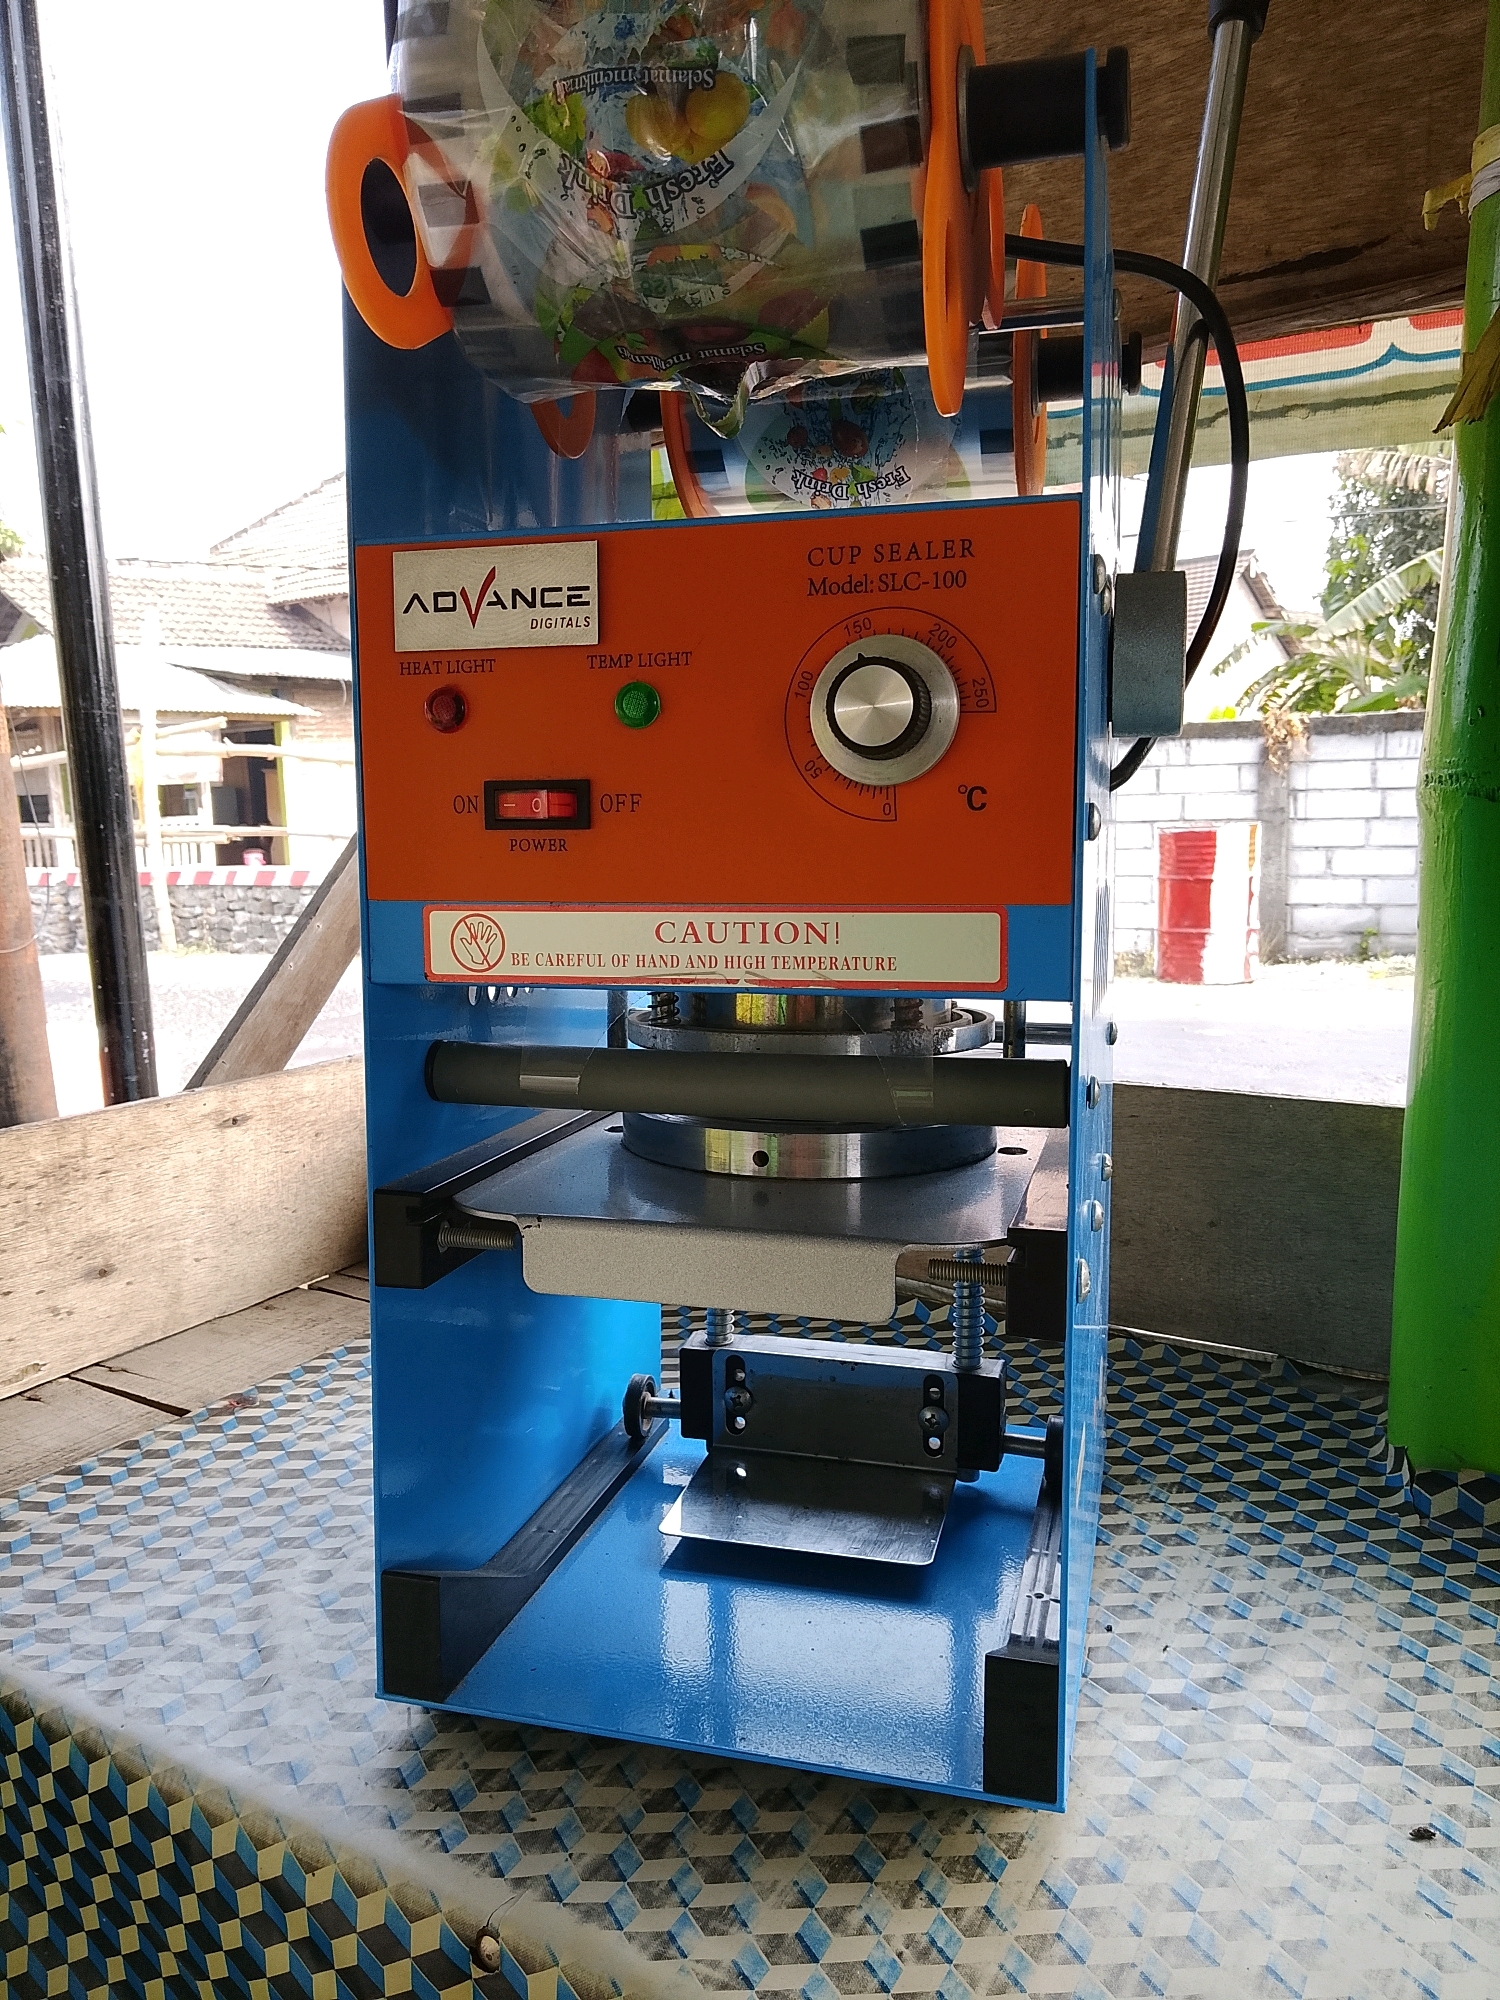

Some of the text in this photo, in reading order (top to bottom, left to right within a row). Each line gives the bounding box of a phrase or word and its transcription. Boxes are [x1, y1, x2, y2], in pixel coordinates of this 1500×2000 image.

[643, 68, 714, 89] Selamat
[556, 148, 735, 220] Fresh Drink
[698, 343, 766, 360] Selamat
[791, 466, 912, 501] Fresh Drink
[807, 538, 976, 567] CUP SEALER
[807, 569, 967, 597] Model: SLC-100
[402, 565, 592, 629] ADVANCE
[530, 615, 591, 630] DIGITALS
[843, 617, 873, 638] 150
[927, 622, 958, 650] 200
[399, 658, 497, 676] HEAT LIGHT
[586, 651, 694, 670] TEMP LIGHT
[793, 670, 815, 700] 100
[970, 676, 990, 709] 250
[803, 759, 823, 780] 50
[453, 794, 479, 815] ON
[600, 793, 643, 814] OFF
[882, 802, 892, 816] 0
[509, 837, 569, 853] POWER
[654, 919, 841, 946] CAUTION!
[510, 952, 898, 973] BE CAREFUL OF HAND AND HIGH TEMPERATURE
